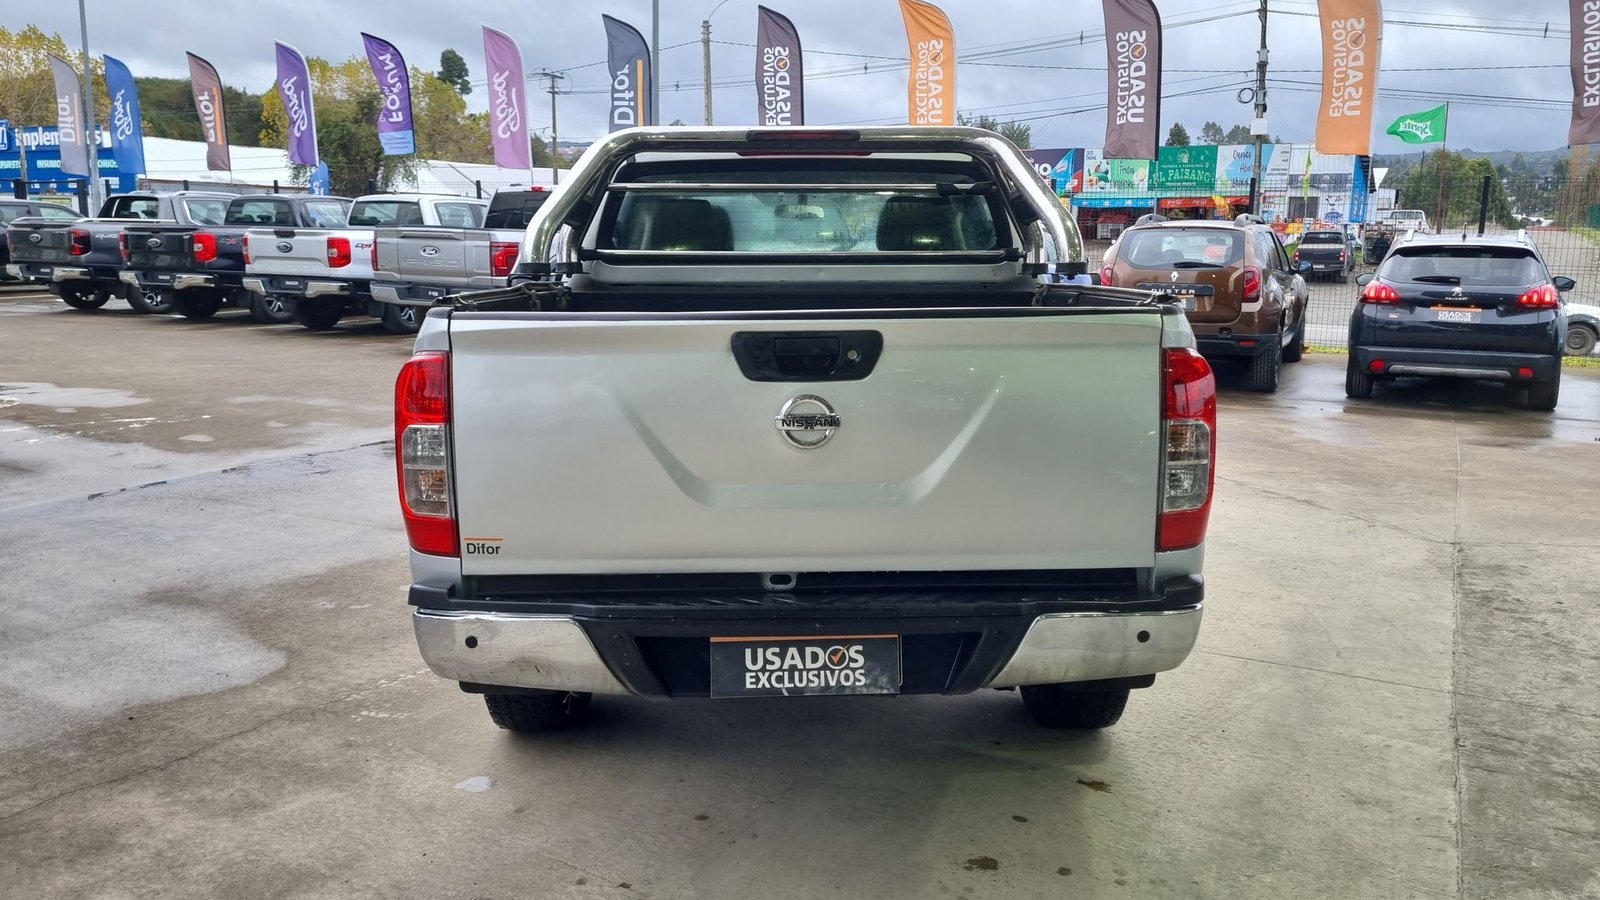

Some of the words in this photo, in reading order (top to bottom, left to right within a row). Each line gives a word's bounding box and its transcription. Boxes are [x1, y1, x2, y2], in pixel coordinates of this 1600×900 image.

[781, 418, 834, 428] NISSAN
[466, 542, 501, 555] Difor
[744, 645, 865, 670] USADOS
[745, 669, 866, 689] EXCLUSIVOS
